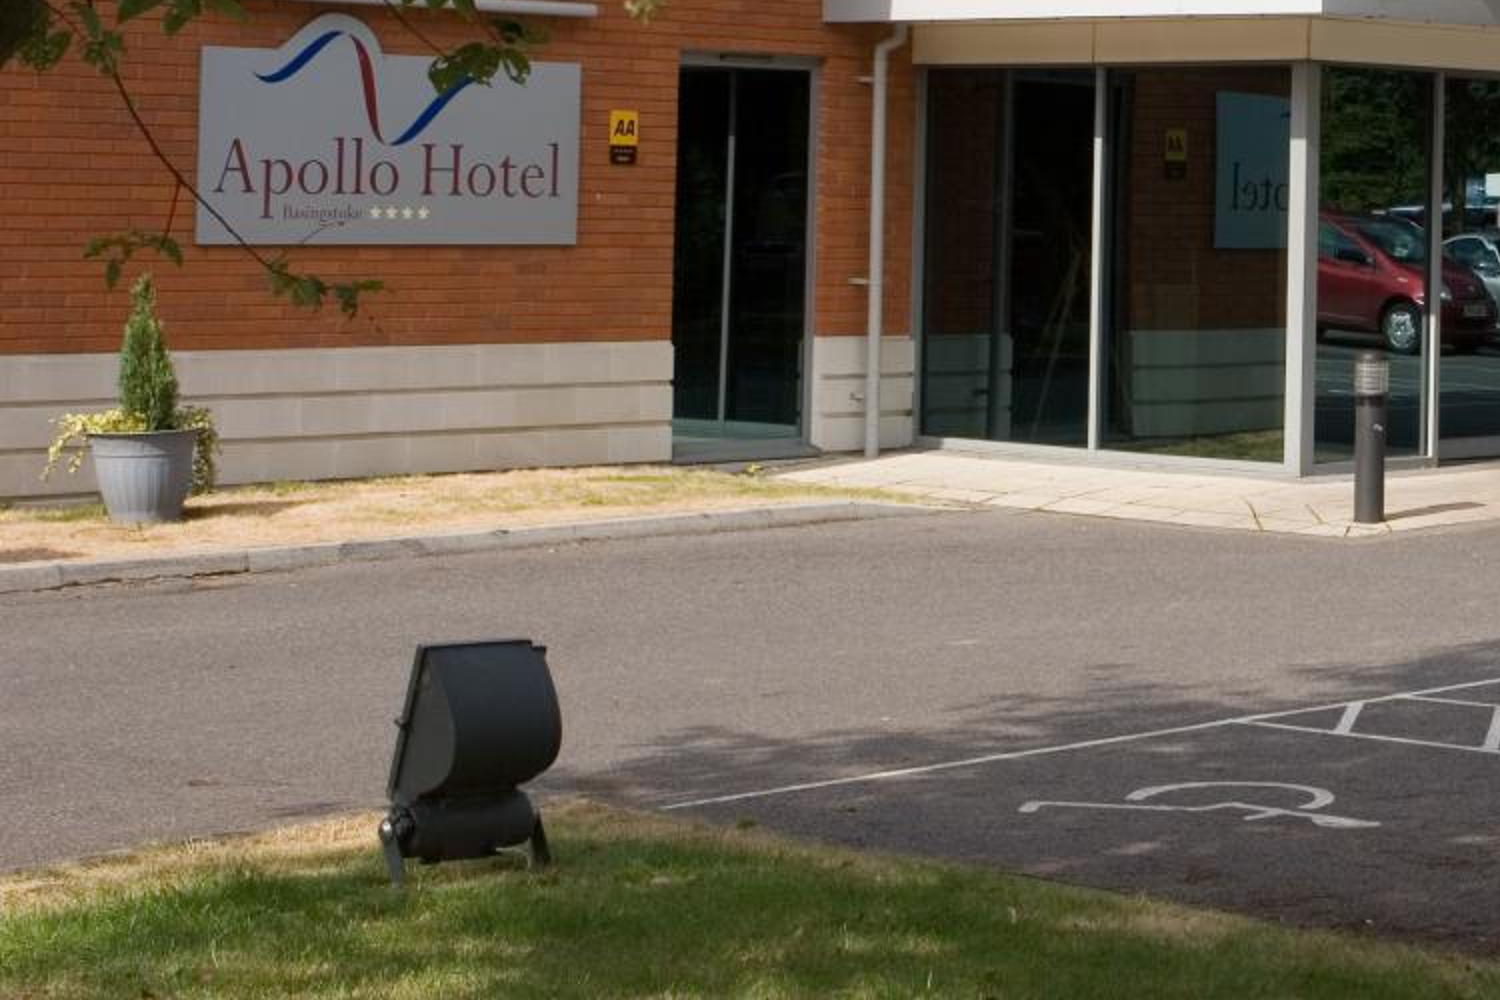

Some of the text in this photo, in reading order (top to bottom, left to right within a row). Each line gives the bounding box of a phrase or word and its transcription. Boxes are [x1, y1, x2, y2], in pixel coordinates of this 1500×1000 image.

[614, 119, 635, 137] AA
[213, 137, 560, 220] Apollo Hotel
